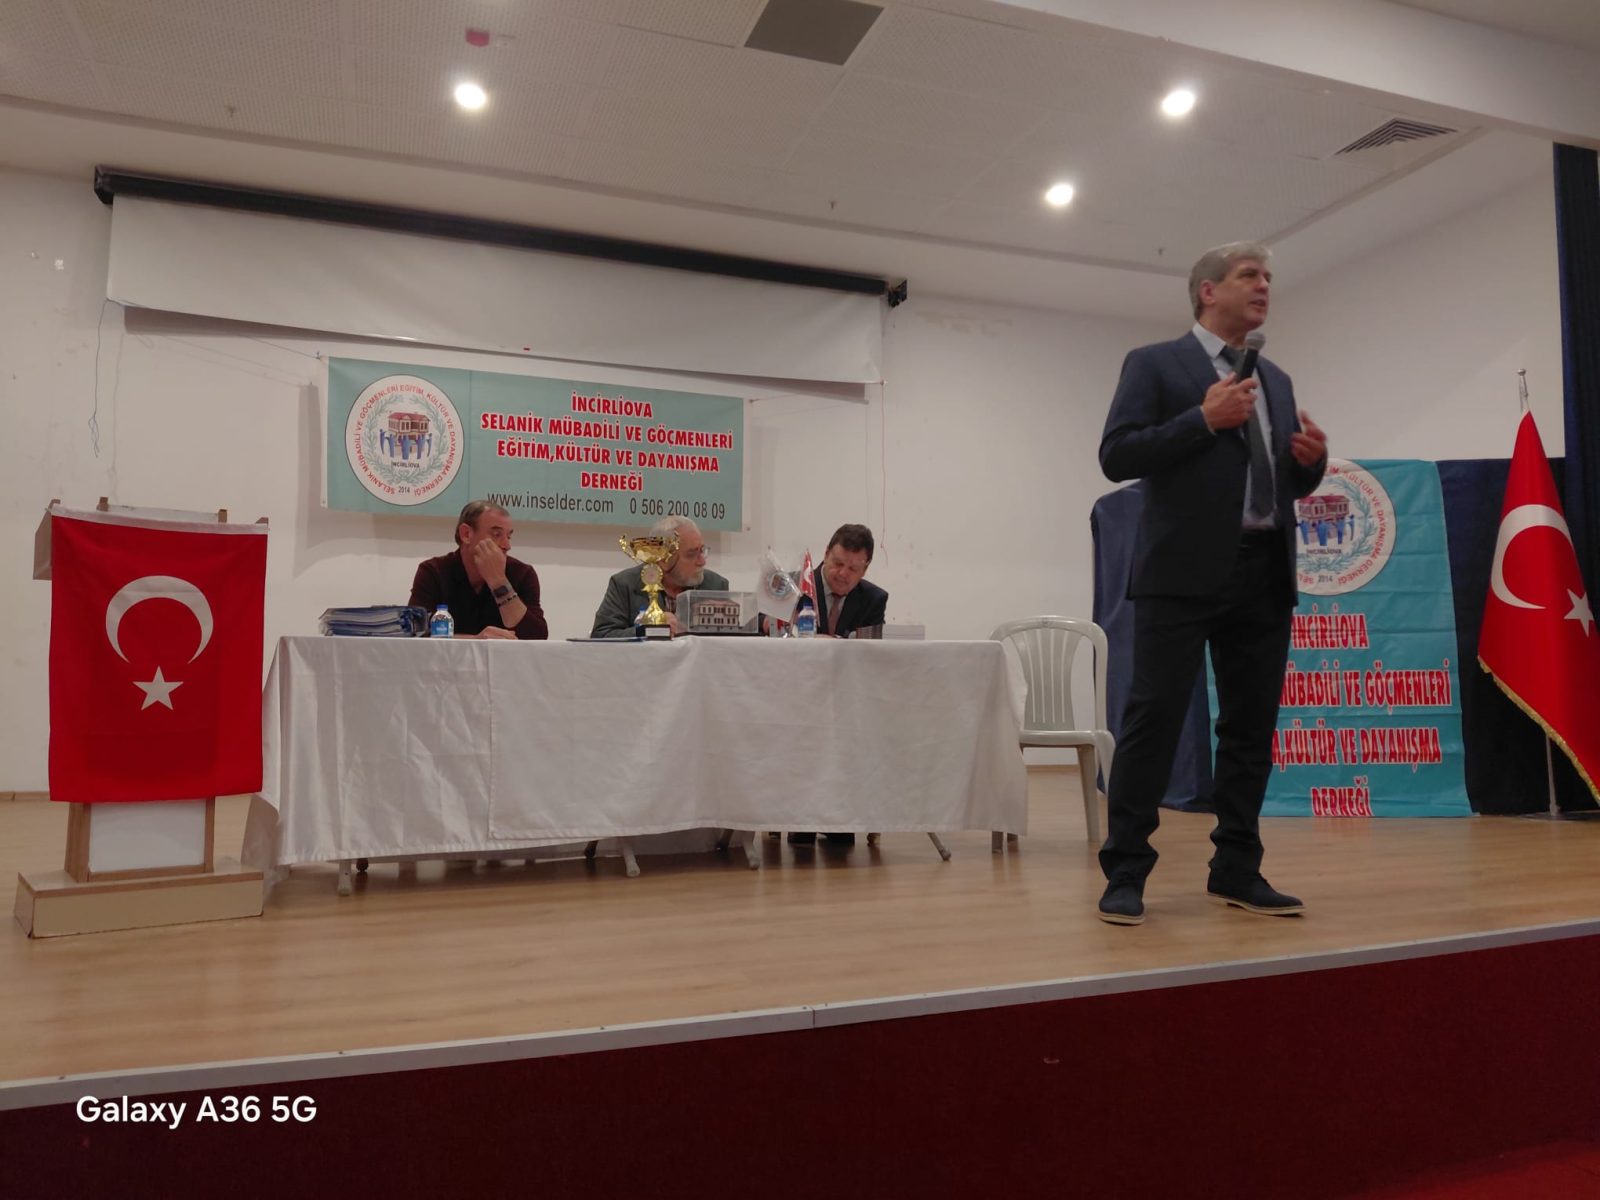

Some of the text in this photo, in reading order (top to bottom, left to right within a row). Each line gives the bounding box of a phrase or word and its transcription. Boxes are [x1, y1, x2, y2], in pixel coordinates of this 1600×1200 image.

[355, 420, 364, 431] VE
[426, 392, 450, 418] KÜLTÜR
[446, 418, 455, 429] VE
[571, 390, 653, 418] İNCİRLİOVA
[481, 412, 733, 449] SELANİK MÜBADİLİ VE GÖÇMENLERİ
[497, 437, 719, 474] EĞİTİM,KÜLTÜR VE DAYANIŞMA
[581, 471, 642, 491] DERNEĞİ
[487, 490, 725, 519] www.inselder.com 0 506 200 08 09
[1343, 670, 1362, 706] VE
[1364, 658, 1452, 714] GÖÇMENLERİ
[1271, 718, 1442, 772] M,KÜLTÜR VE DAYANIŞMA
[1311, 775, 1374, 816] DERNEĞİ
